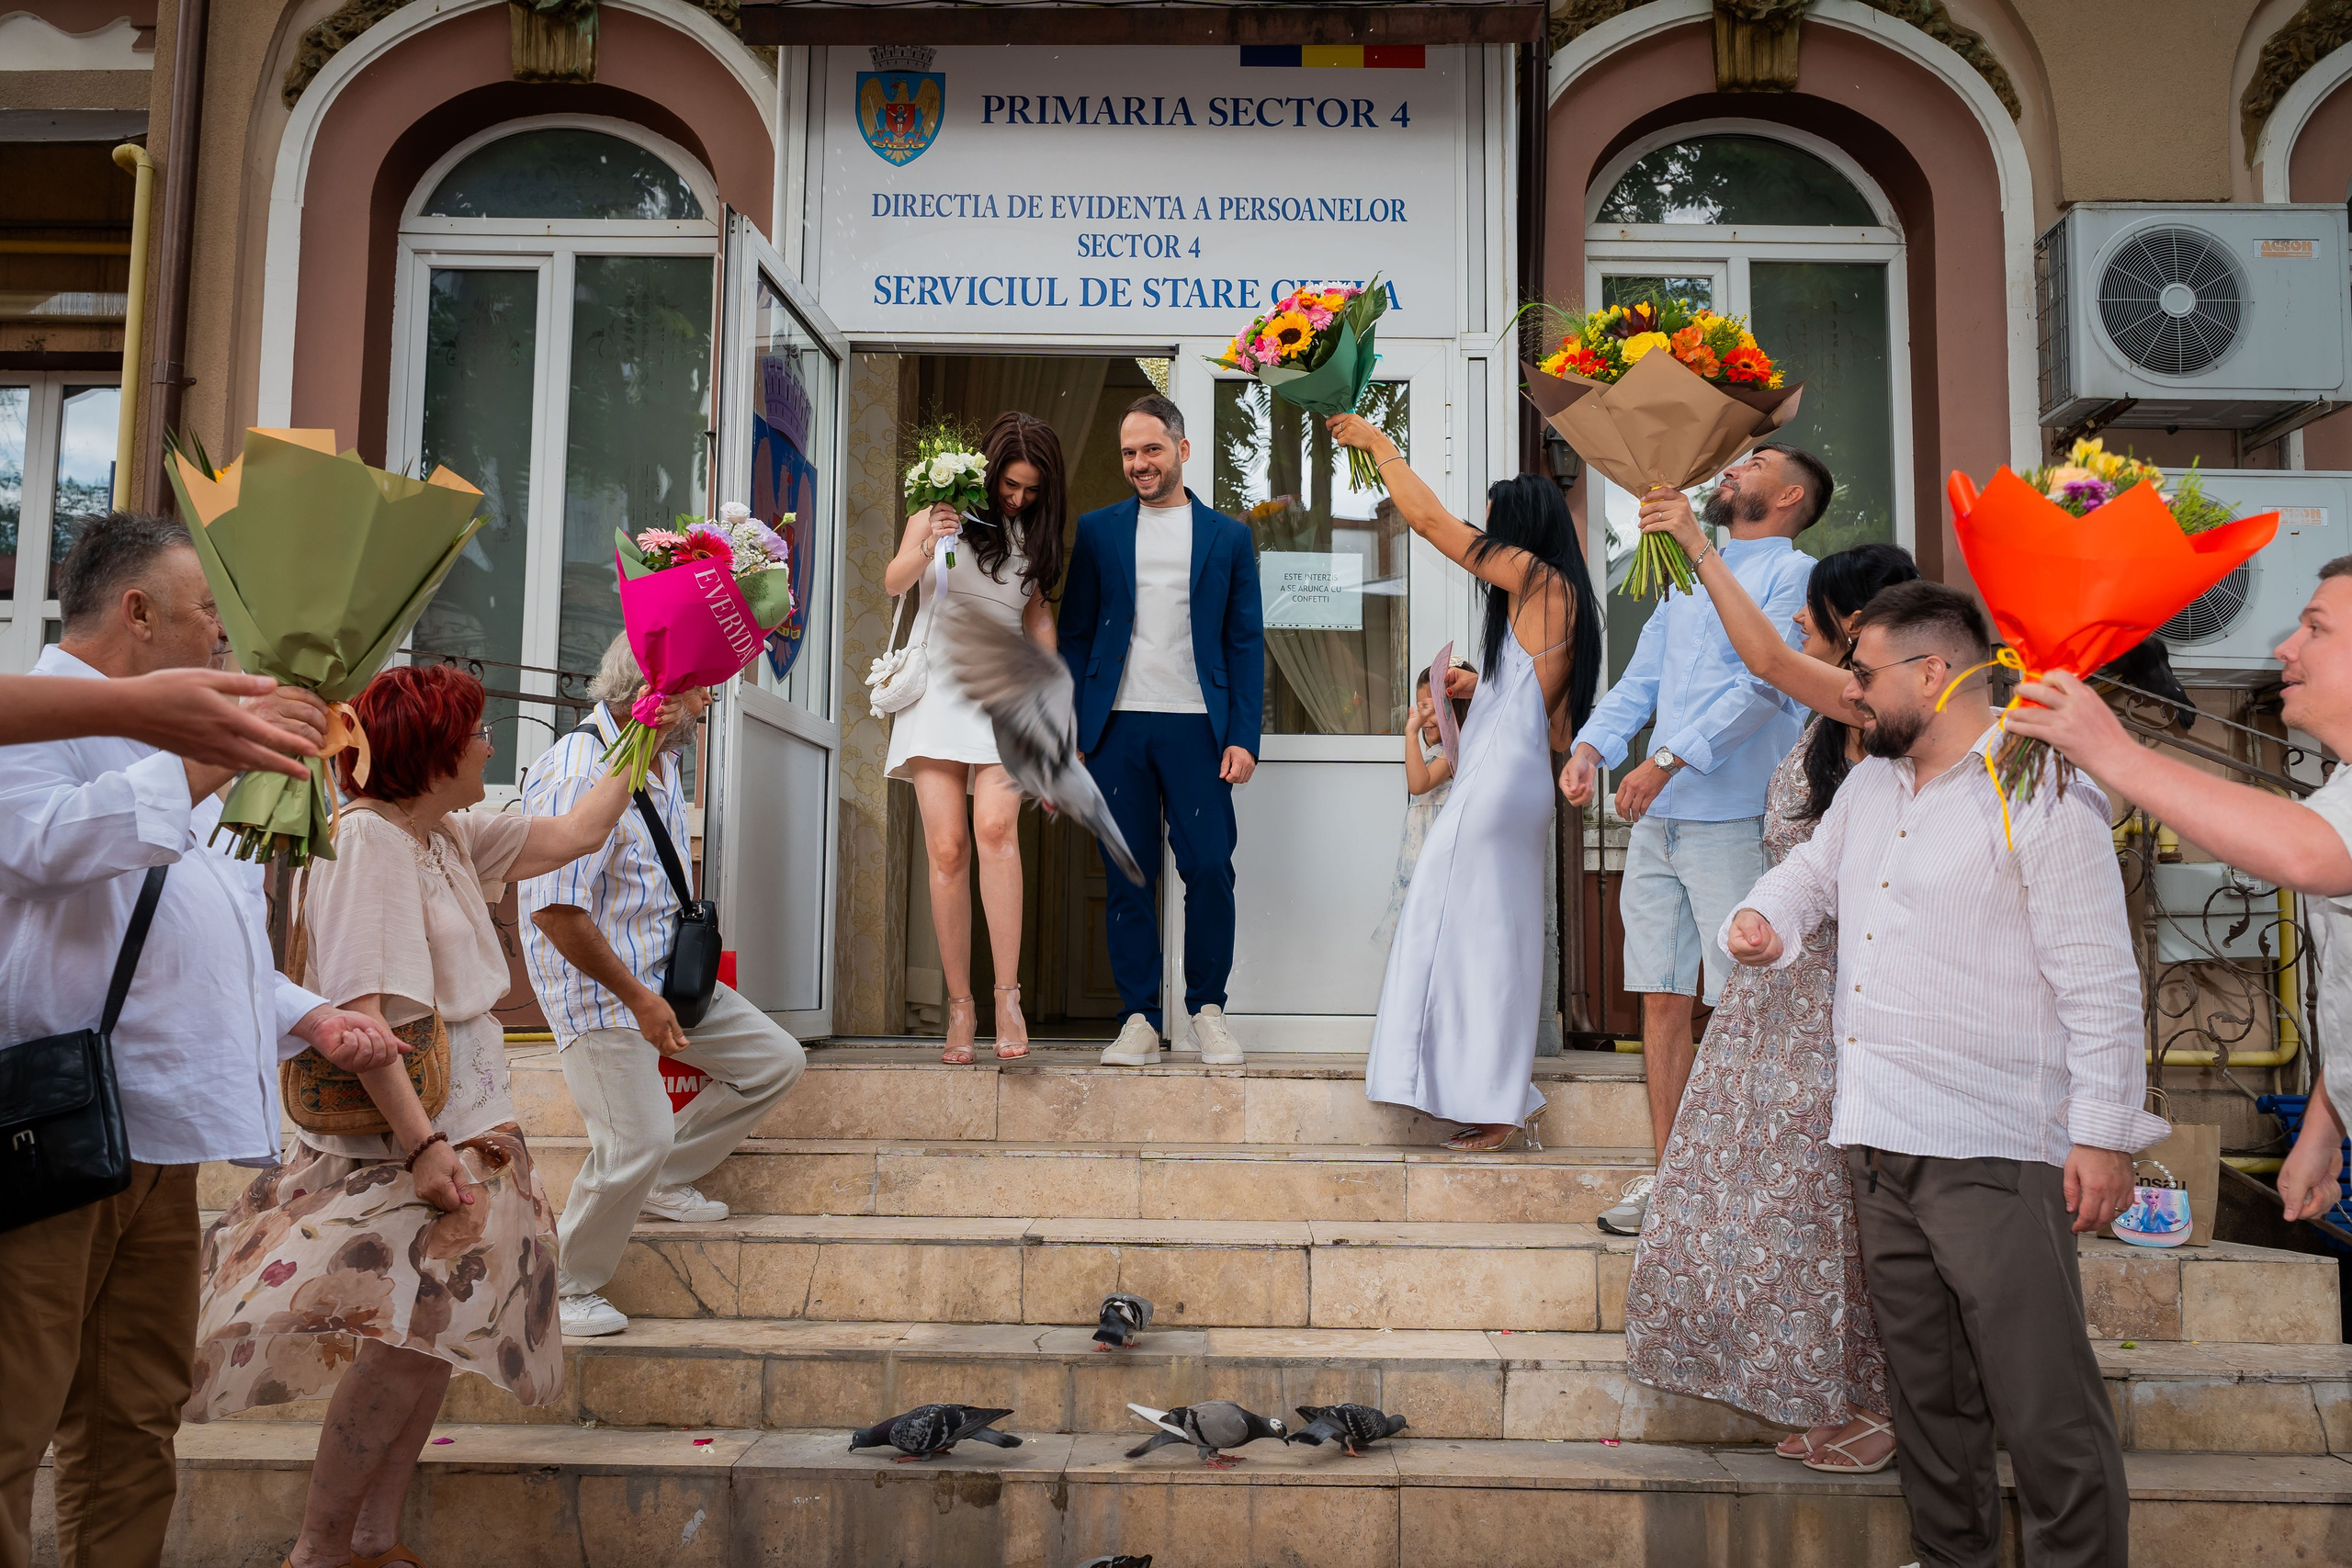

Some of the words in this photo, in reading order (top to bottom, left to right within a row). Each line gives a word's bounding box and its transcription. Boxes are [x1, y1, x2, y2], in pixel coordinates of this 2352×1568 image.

[980, 95, 1196, 127] PRIMARIA
[1208, 96, 1379, 129] SECTOR
[1390, 101, 1411, 129] 4
[871, 192, 1000, 220] DIRECTIA
[1007, 194, 1044, 220] DE
[1050, 195, 1185, 221] EVIDENTA
[1193, 196, 1213, 221] A
[1219, 197, 1408, 223] PERSOANELOR
[1077, 232, 1182, 259] SECTOR
[1187, 235, 1202, 259] 4
[872, 274, 1069, 309] SERVICIUL
[1080, 276, 1134, 309] DE
[1142, 276, 1262, 310] STARE
[1283, 572, 1303, 581] ESTE
[1305, 573, 1339, 581] INTERZIS
[1286, 584, 1296, 592] SE
[694, 566, 757, 666] EVERYDA
